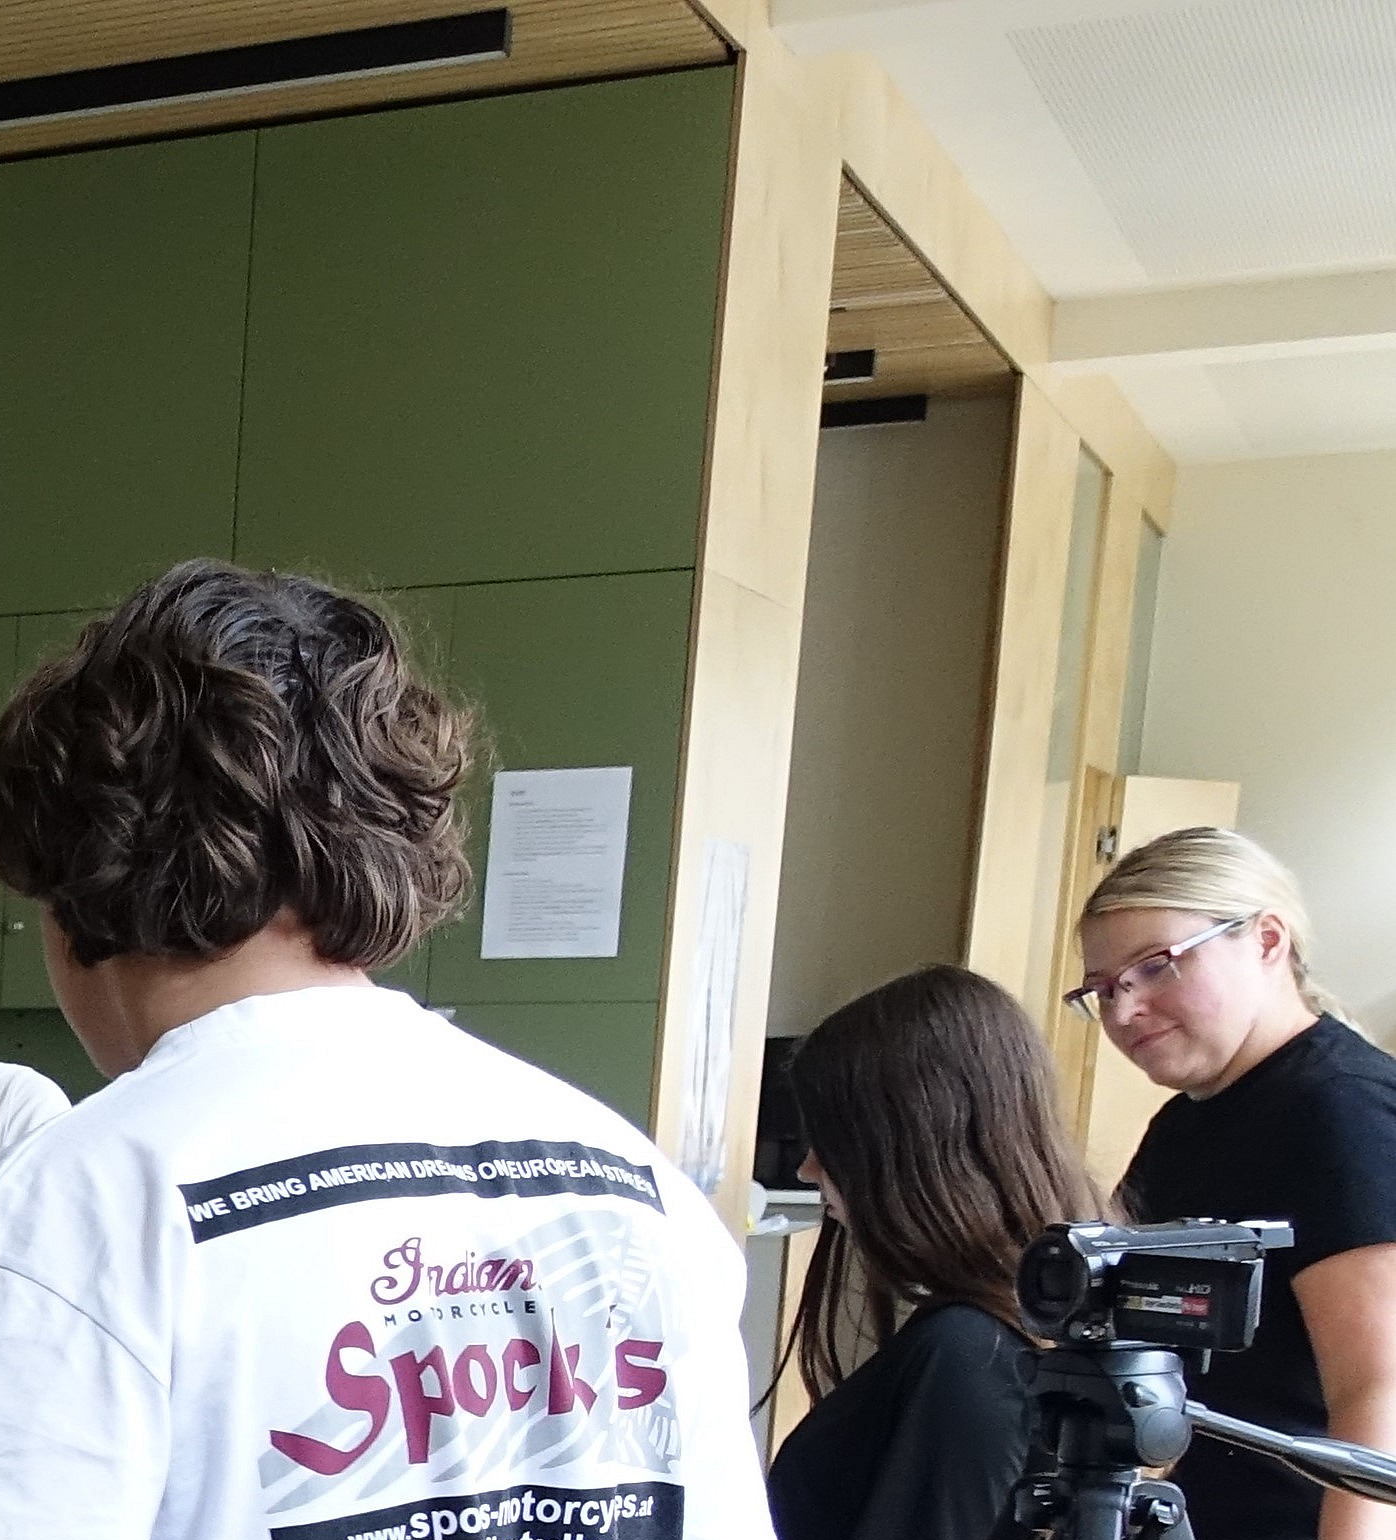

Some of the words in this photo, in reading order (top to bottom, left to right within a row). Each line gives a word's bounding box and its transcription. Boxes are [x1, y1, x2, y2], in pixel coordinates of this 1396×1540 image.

[187, 1197, 231, 1223] WE
[230, 1177, 307, 1210] BRING
[308, 1160, 412, 1191] AMERICAN
[478, 1159, 508, 1181] ON
[506, 1157, 605, 1180] EUROPEAN
[370, 1236, 537, 1305] Indian
[383, 1300, 537, 1327] MOTORCYCLE
